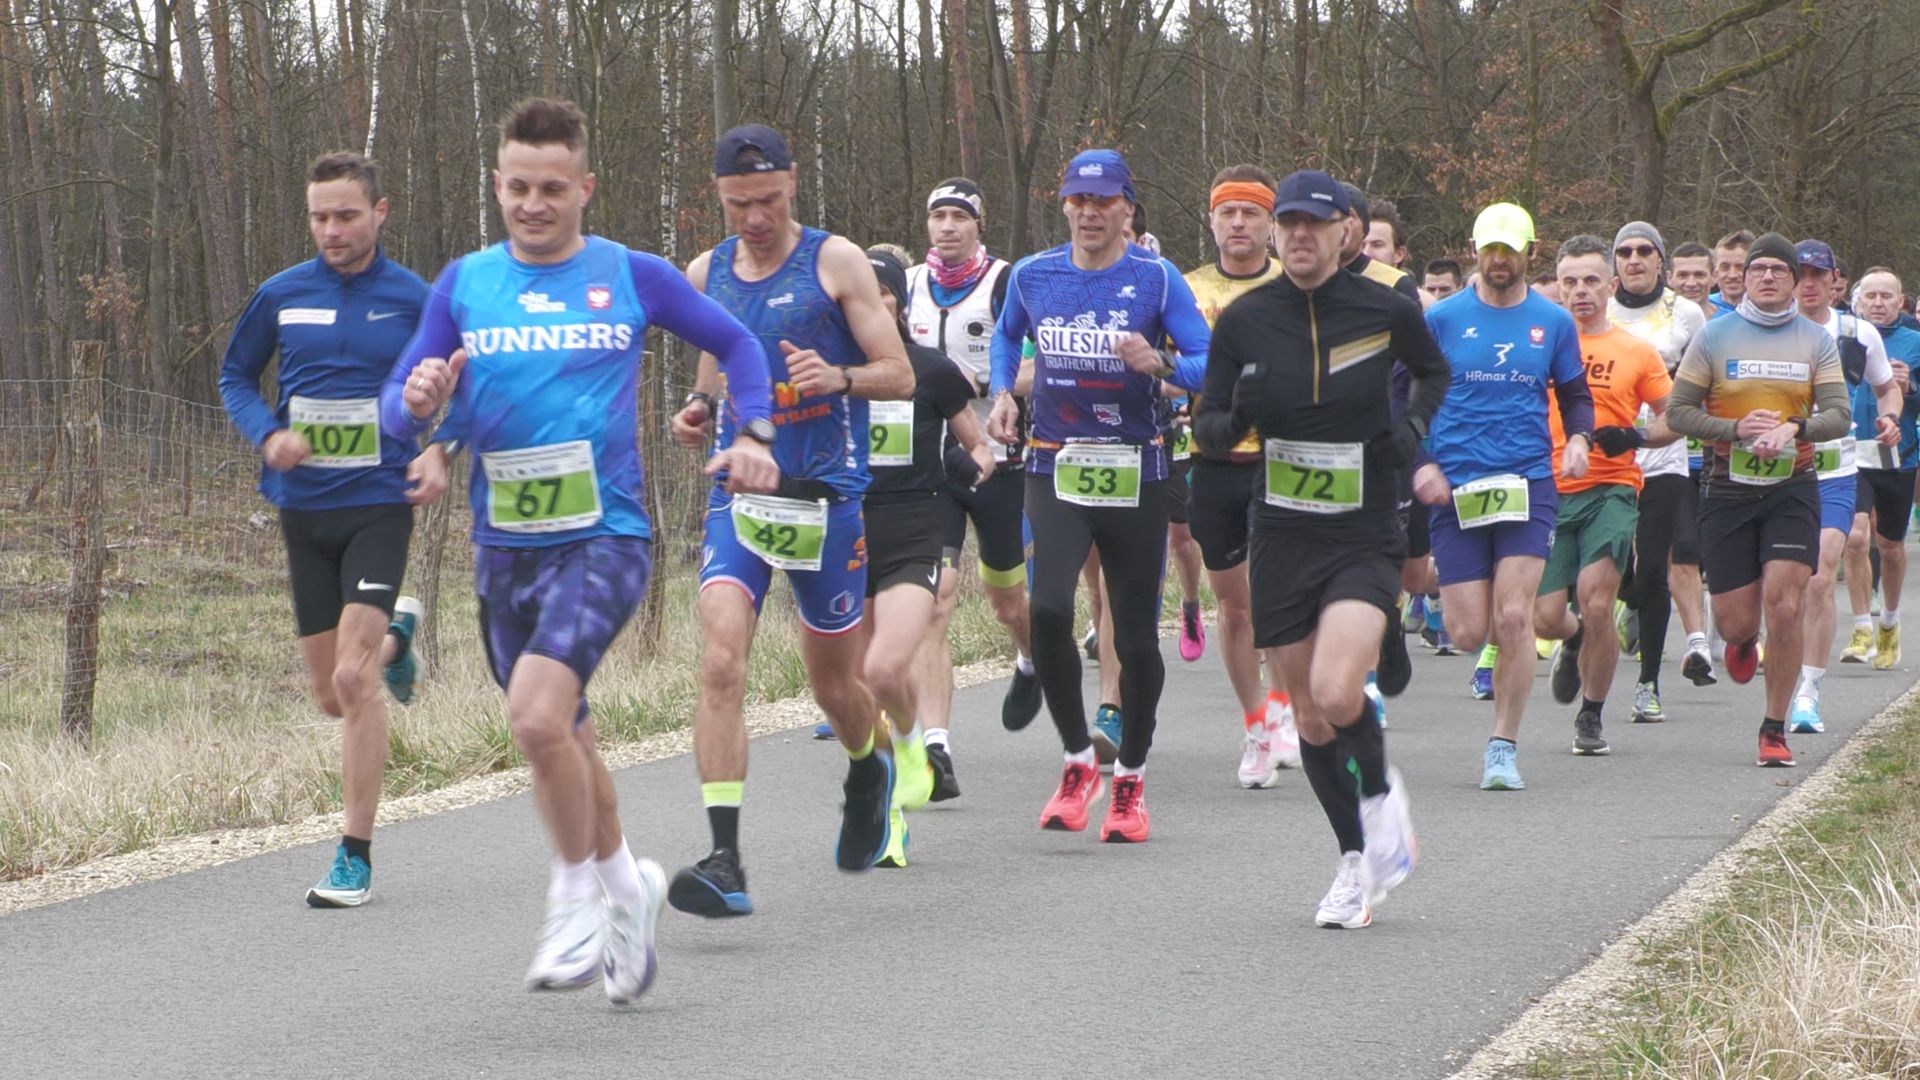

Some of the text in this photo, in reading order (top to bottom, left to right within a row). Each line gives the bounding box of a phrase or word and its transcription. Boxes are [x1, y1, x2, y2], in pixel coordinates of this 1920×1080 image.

[461, 323, 633, 358] RUNNERS
[1044, 355, 1126, 373] TRIATHLON TEAM
[1465, 369, 1537, 386] HRmax Żory
[1582, 354, 1615, 381] ie!
[1739, 363, 1763, 375] SCI
[302, 424, 365, 456] 107
[1745, 455, 1778, 476] 49
[1077, 467, 1117, 495] 53
[1291, 465, 1335, 500] 72
[516, 478, 563, 518] 67
[1474, 488, 1509, 516] 79
[754, 523, 798, 557] 42
